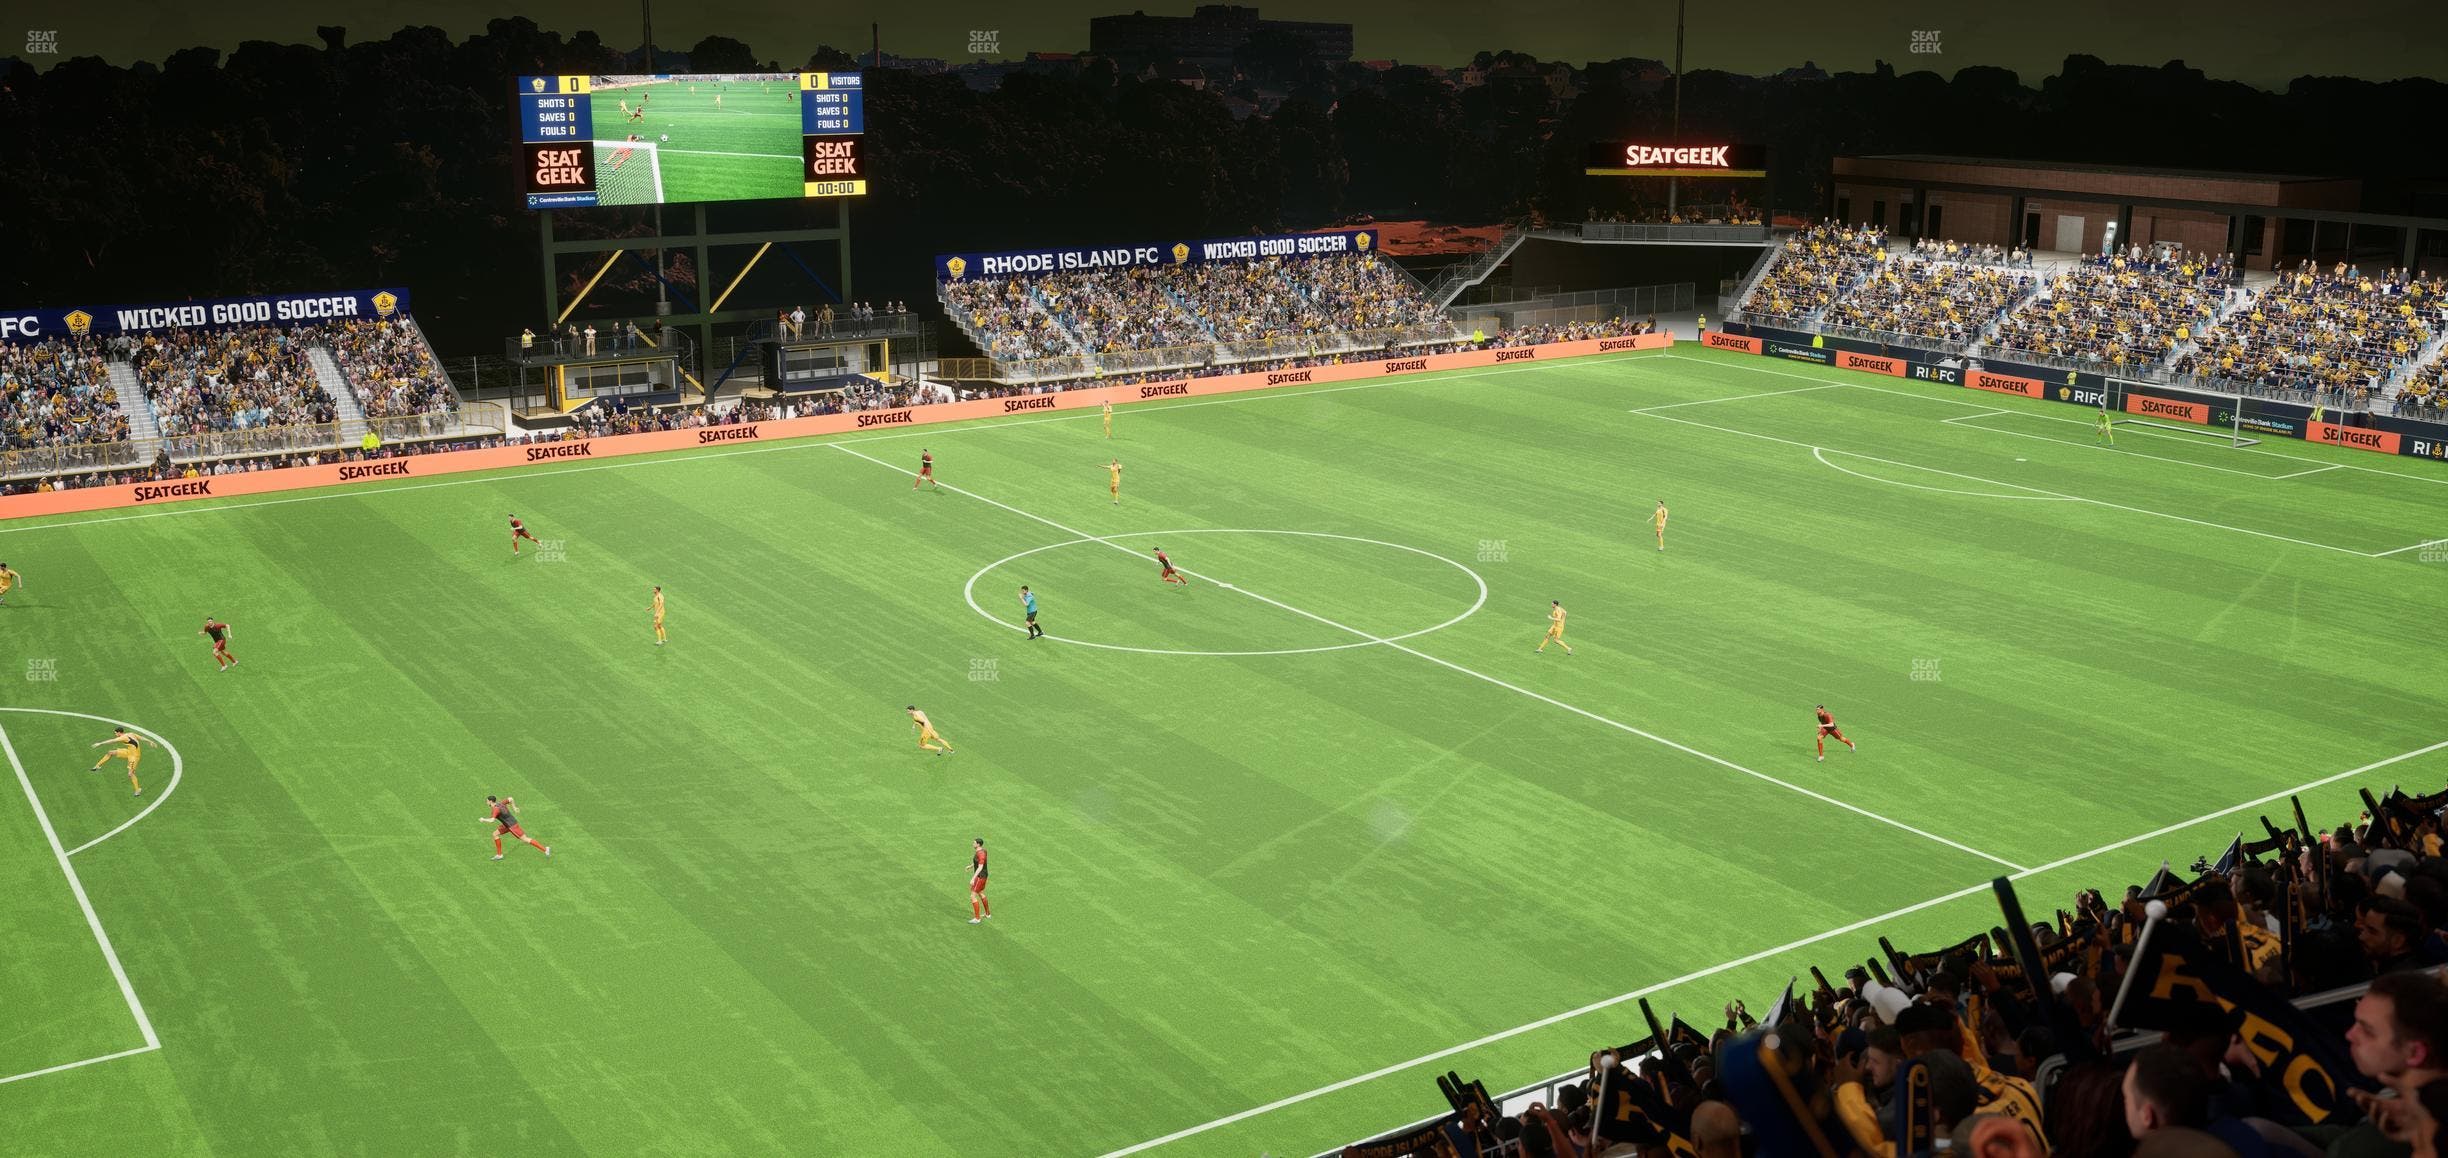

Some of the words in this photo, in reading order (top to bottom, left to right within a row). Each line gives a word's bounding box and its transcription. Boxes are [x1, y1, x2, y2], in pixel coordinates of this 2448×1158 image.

[570, 78, 579, 92] 0
[810, 74, 818, 88] 0
[830, 76, 860, 86] VISITORS
[538, 98, 565, 108] SHOTS
[568, 98, 574, 108] 0
[816, 94, 840, 102] SHOTS
[842, 94, 848, 102] 0
[539, 112, 566, 122] SAVES
[569, 112, 575, 122] 0
[817, 107, 840, 116] SAVES
[843, 106, 848, 115] 0
[540, 126, 566, 136] FOULS
[569, 126, 576, 135] 0
[817, 120, 840, 128] FOULS
[843, 119, 849, 128] 0
[537, 148, 581, 167] SEAT
[815, 141, 854, 158] SEAT
[1626, 145, 1729, 167] SEATGEEK
[814, 158, 856, 174] GEEK
[536, 166, 585, 185] GEEK
[817, 182, 854, 194] 00:00
[1204, 241, 1256, 260] WICKED
[1260, 238, 1295, 256] GOOD
[1298, 235, 1346, 254] SOCCER
[983, 254, 1054, 274] RHODE
[1059, 249, 1131, 269] ISLAND
[1135, 247, 1158, 264] FC
[0, 316, 40, 338] FC
[117, 306, 207, 330] WICKED
[212, 302, 271, 324] GOOD
[277, 296, 358, 320] SOCCER
[1600, 338, 1636, 352] SEATGEEK
[1711, 336, 1750, 351] SEATGEEK
[1496, 348, 1534, 362] SEATGEEK
[1386, 359, 1427, 374] SEATGEEK
[1848, 356, 1893, 373] SEATGEEK
[1268, 370, 1311, 385] SEATGEEK
[1979, 376, 2029, 394] SEATGEEK
[1141, 382, 1188, 398] SEATGEEK
[1004, 396, 1055, 412] SEATGEEK
[2142, 400, 2192, 419] SEATGEEK
[858, 410, 912, 427] SEATGEEK
[699, 426, 758, 444] SEATGEEK
[2323, 427, 2382, 448] SEATGEEK
[526, 443, 591, 461] SEATGEEK
[339, 460, 409, 480] SEATGEEK
[134, 480, 211, 501] SEATGEEK
